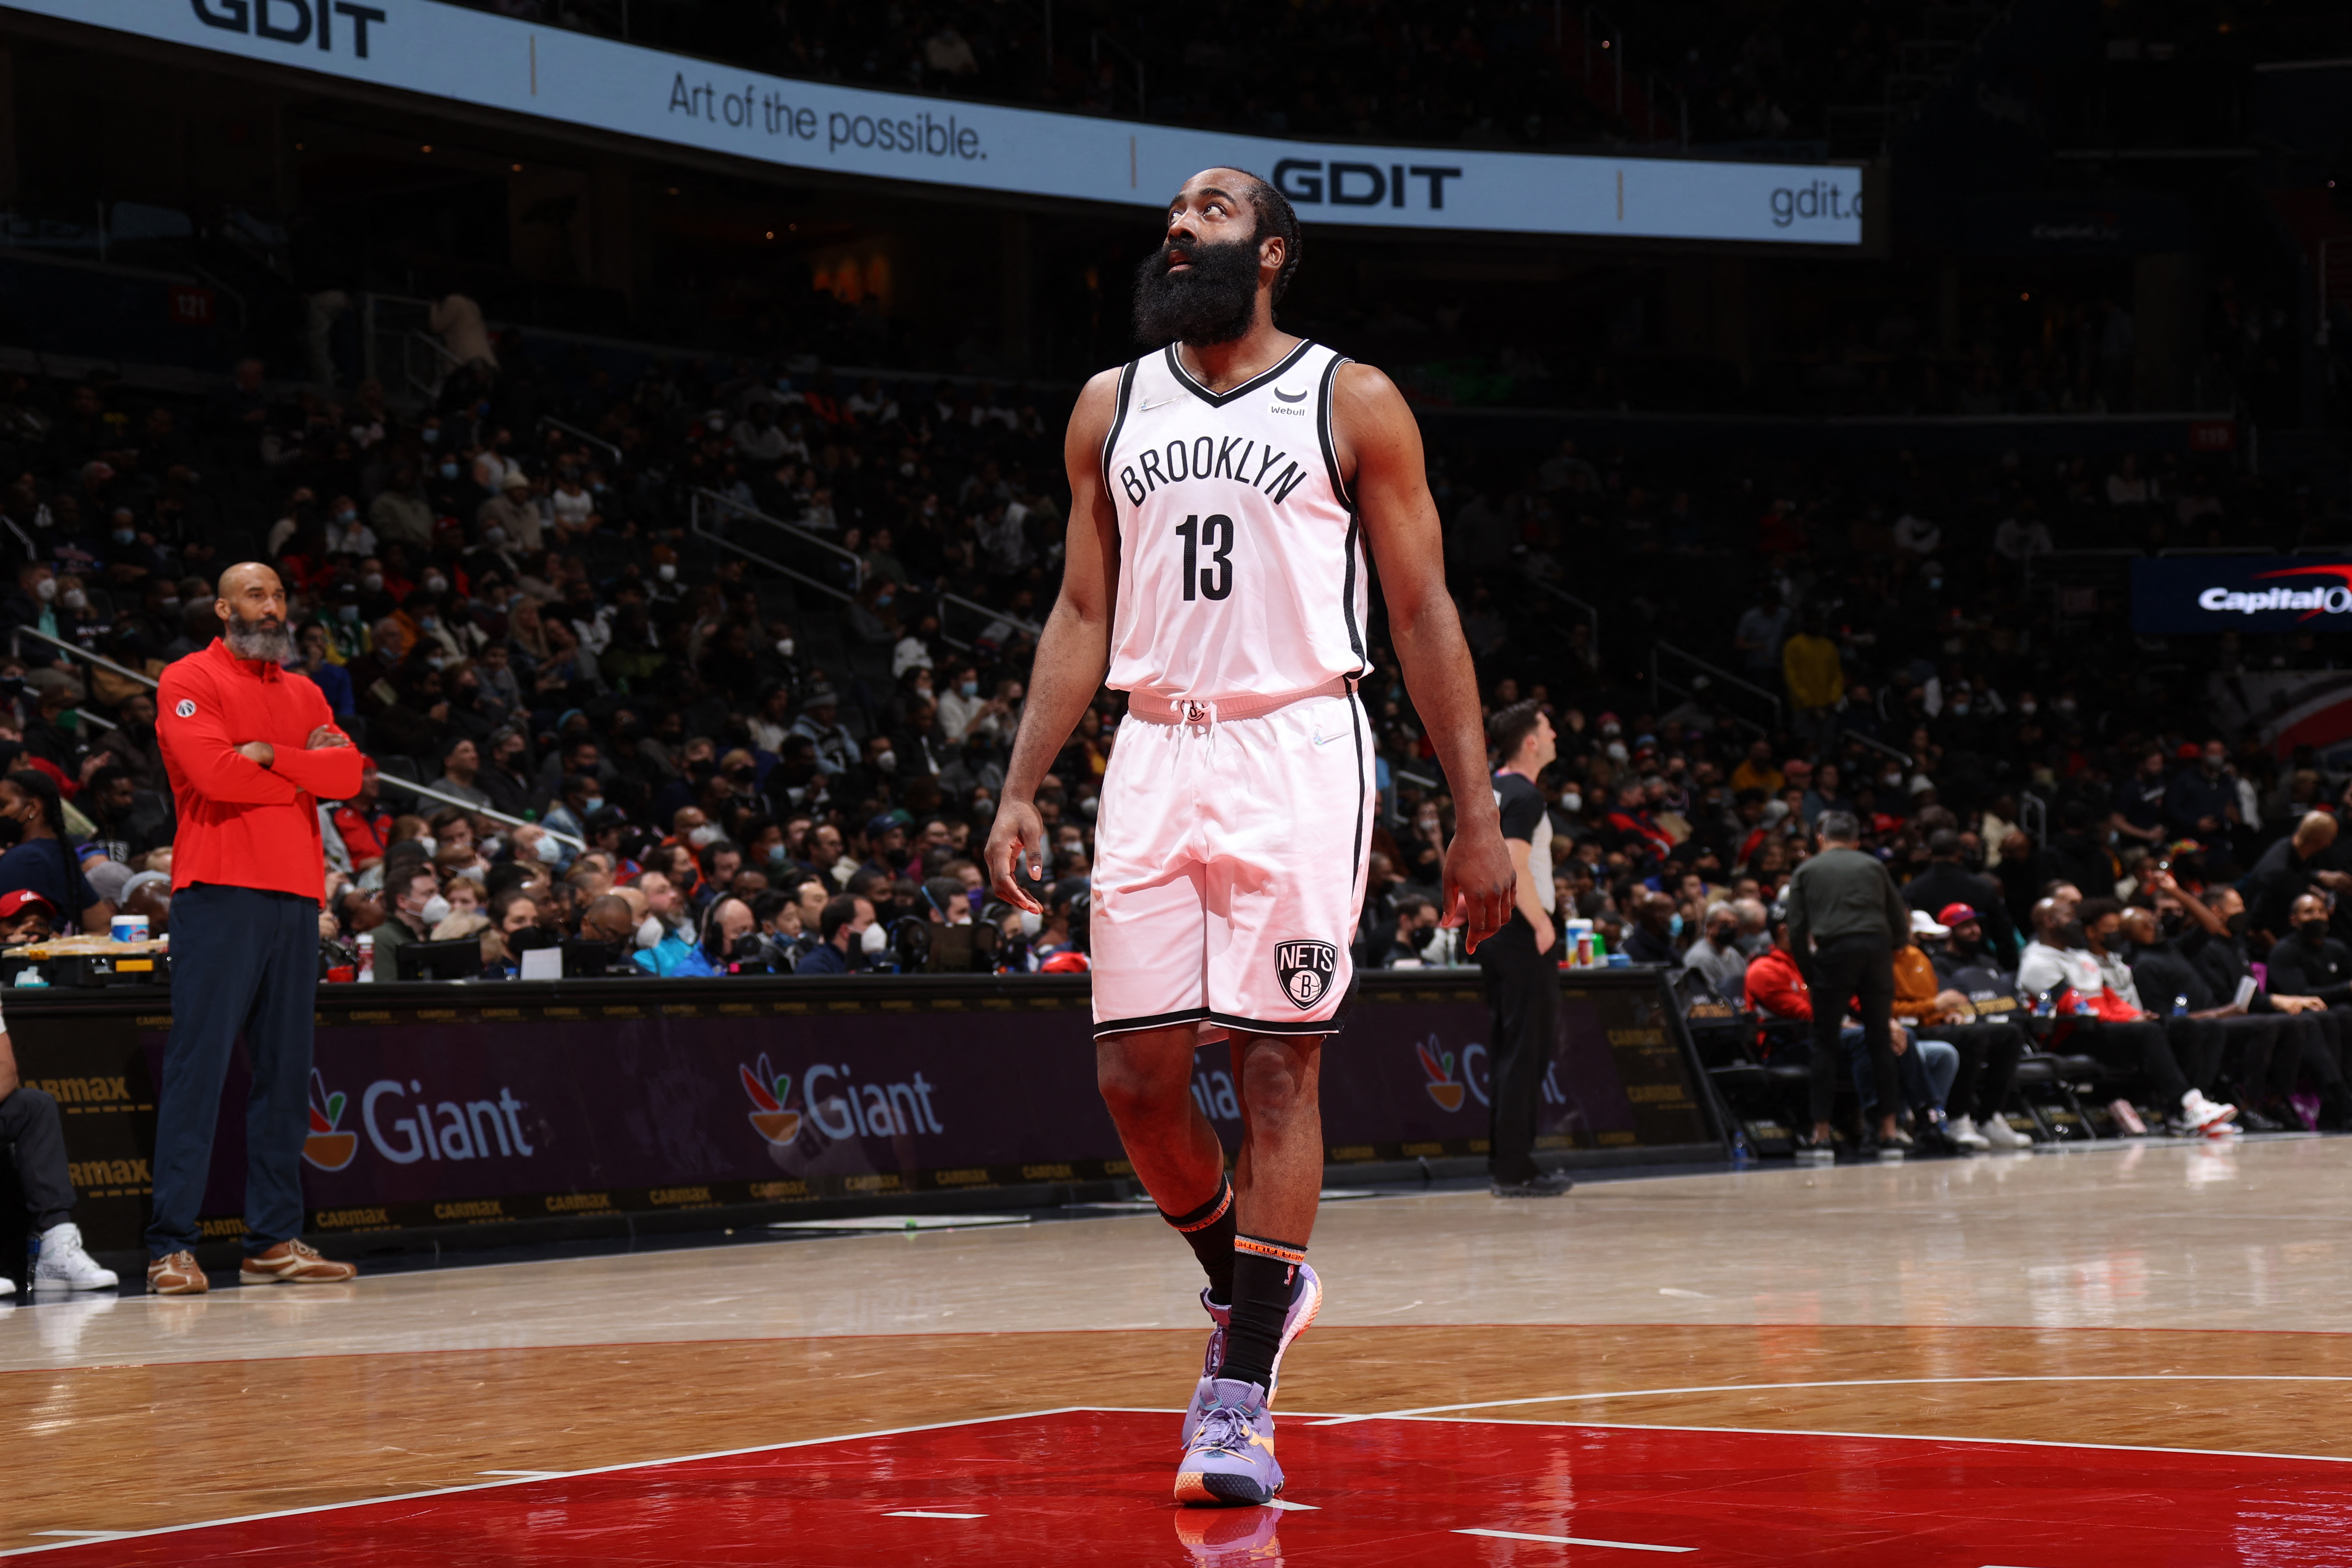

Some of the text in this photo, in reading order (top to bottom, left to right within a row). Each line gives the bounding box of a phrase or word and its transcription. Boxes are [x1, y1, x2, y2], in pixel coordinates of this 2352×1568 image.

[192, 0, 386, 58] GDIT
[669, 71, 987, 161] Art of the possible.
[1273, 157, 1463, 209] GDIT
[176, 294, 207, 319] 121
[1271, 406, 1305, 416] Webull
[1120, 436, 1307, 508] BROOKLYN
[1176, 514, 1234, 601] 13
[2197, 586, 2352, 615] CapitalO
[1280, 945, 1333, 972] NETS
[1301, 974, 1311, 998] B
[362, 1079, 533, 1164] Giant
[803, 1063, 944, 1140] Giant
